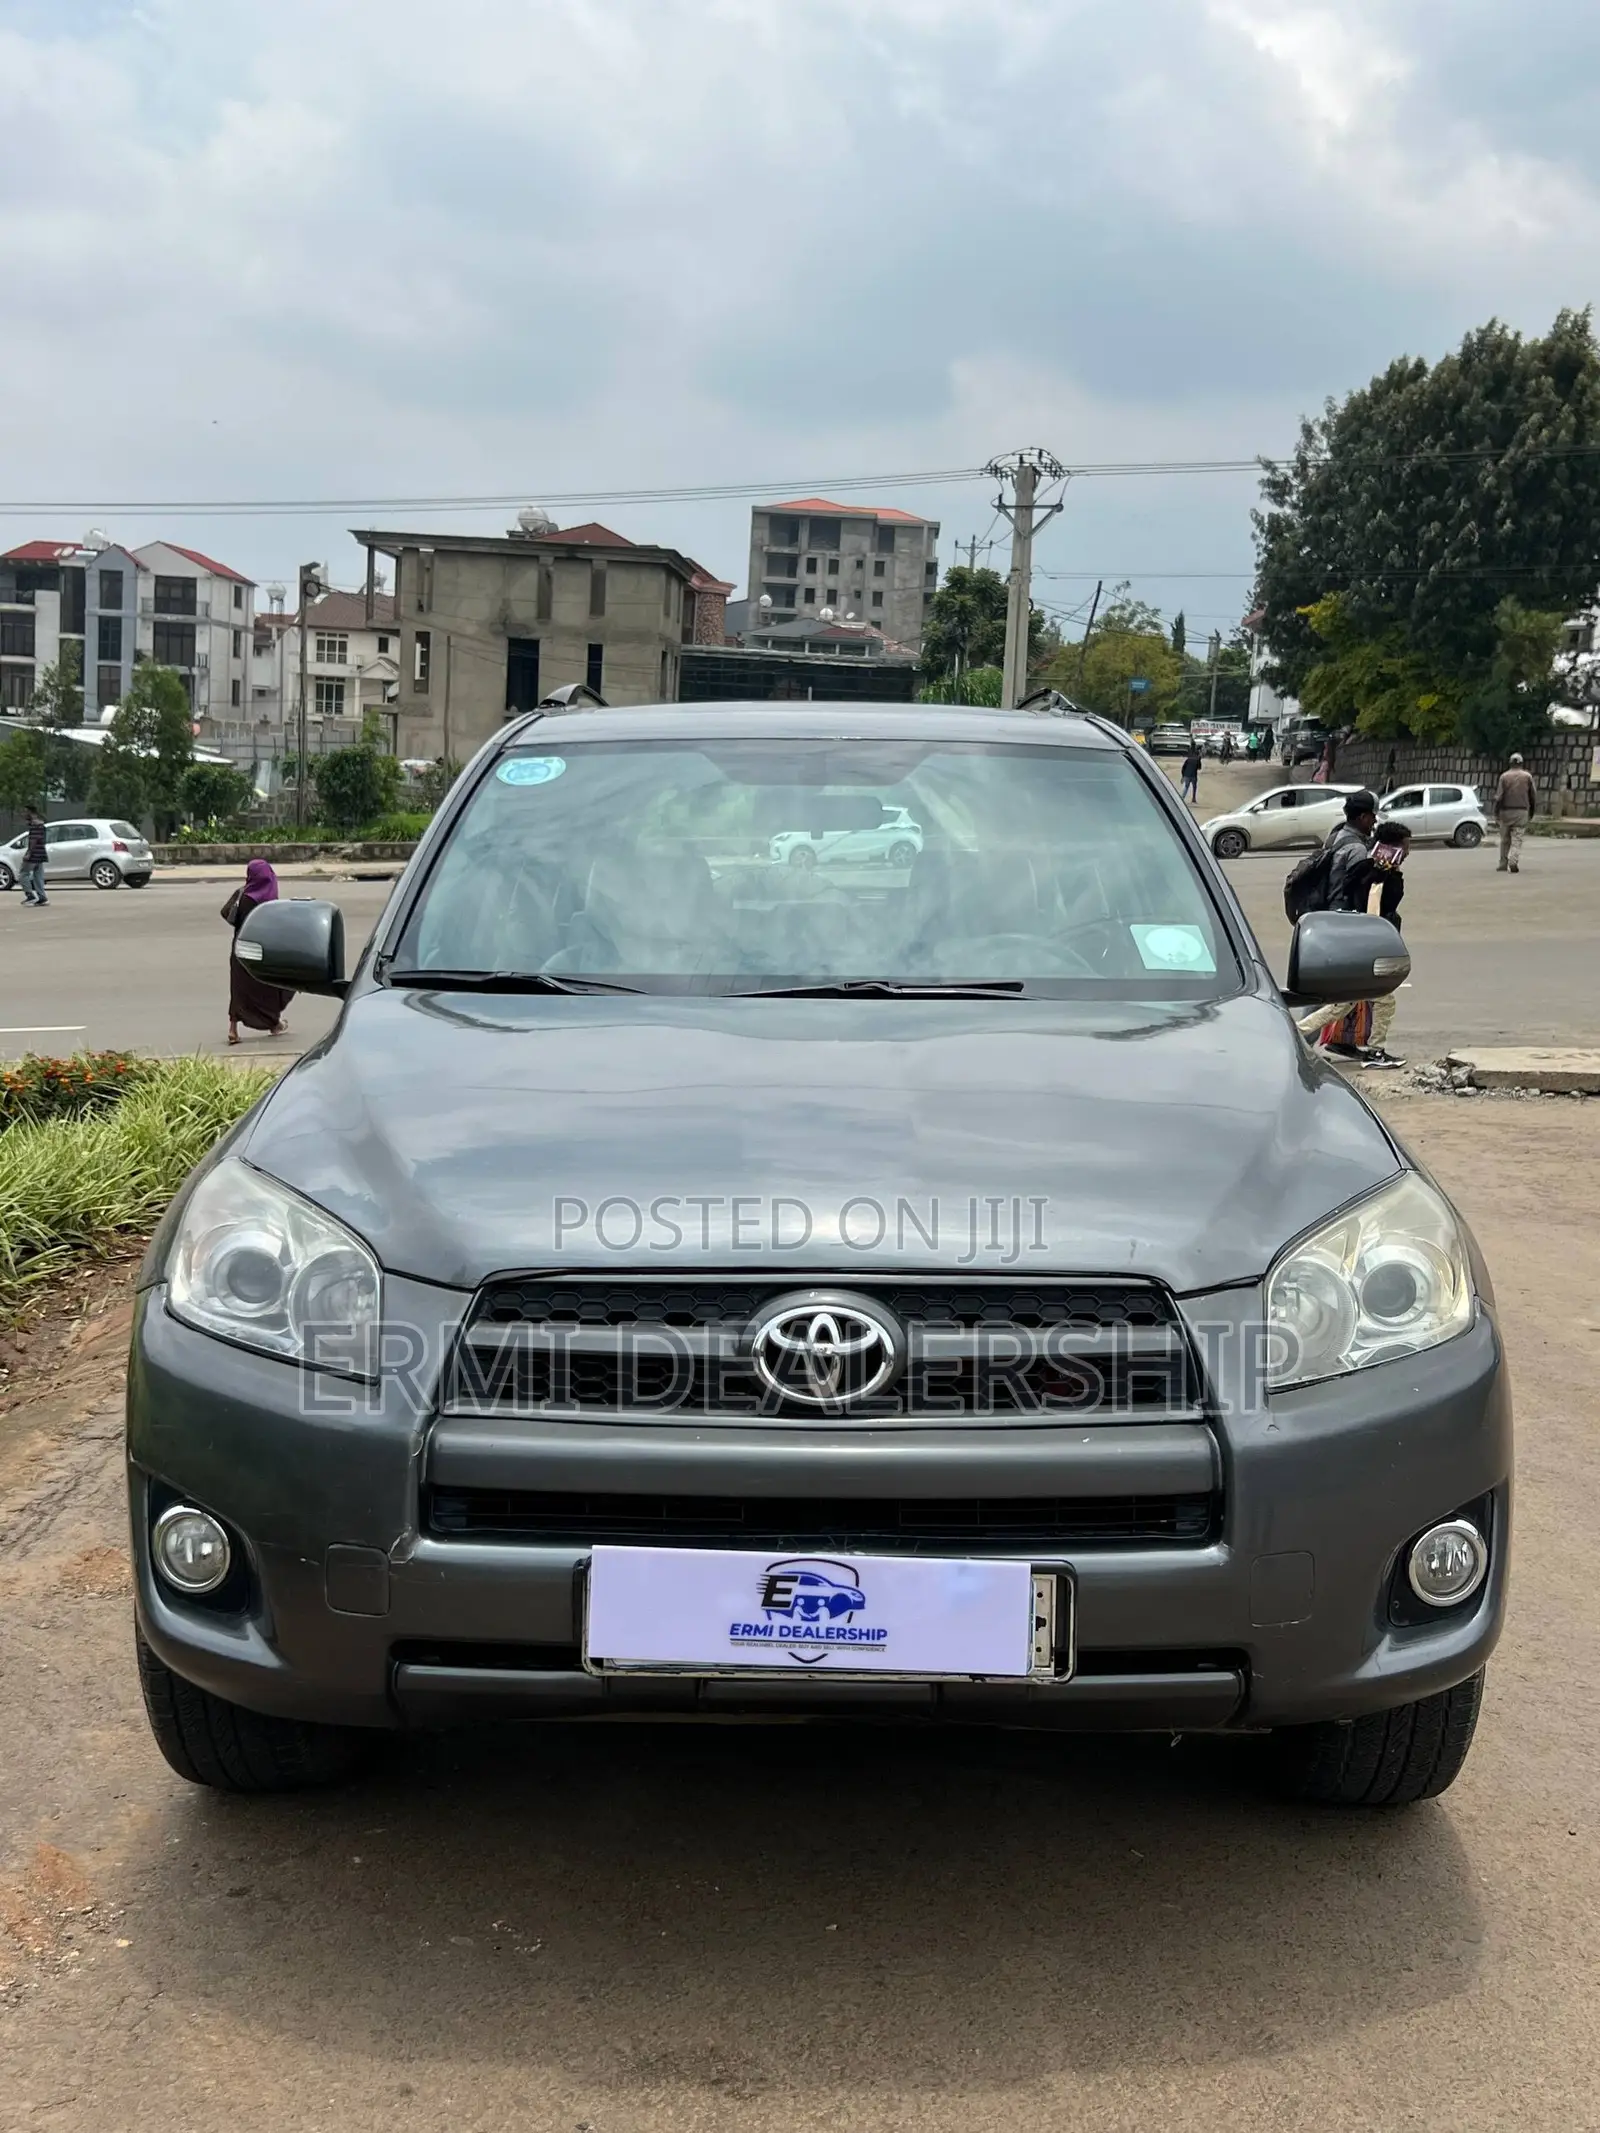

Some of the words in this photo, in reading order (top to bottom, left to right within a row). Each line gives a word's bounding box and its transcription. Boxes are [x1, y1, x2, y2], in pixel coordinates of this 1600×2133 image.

[761, 1575, 799, 1608] E
[729, 1623, 774, 1637] ERMI
[779, 1625, 888, 1641] DEALERSHIP
